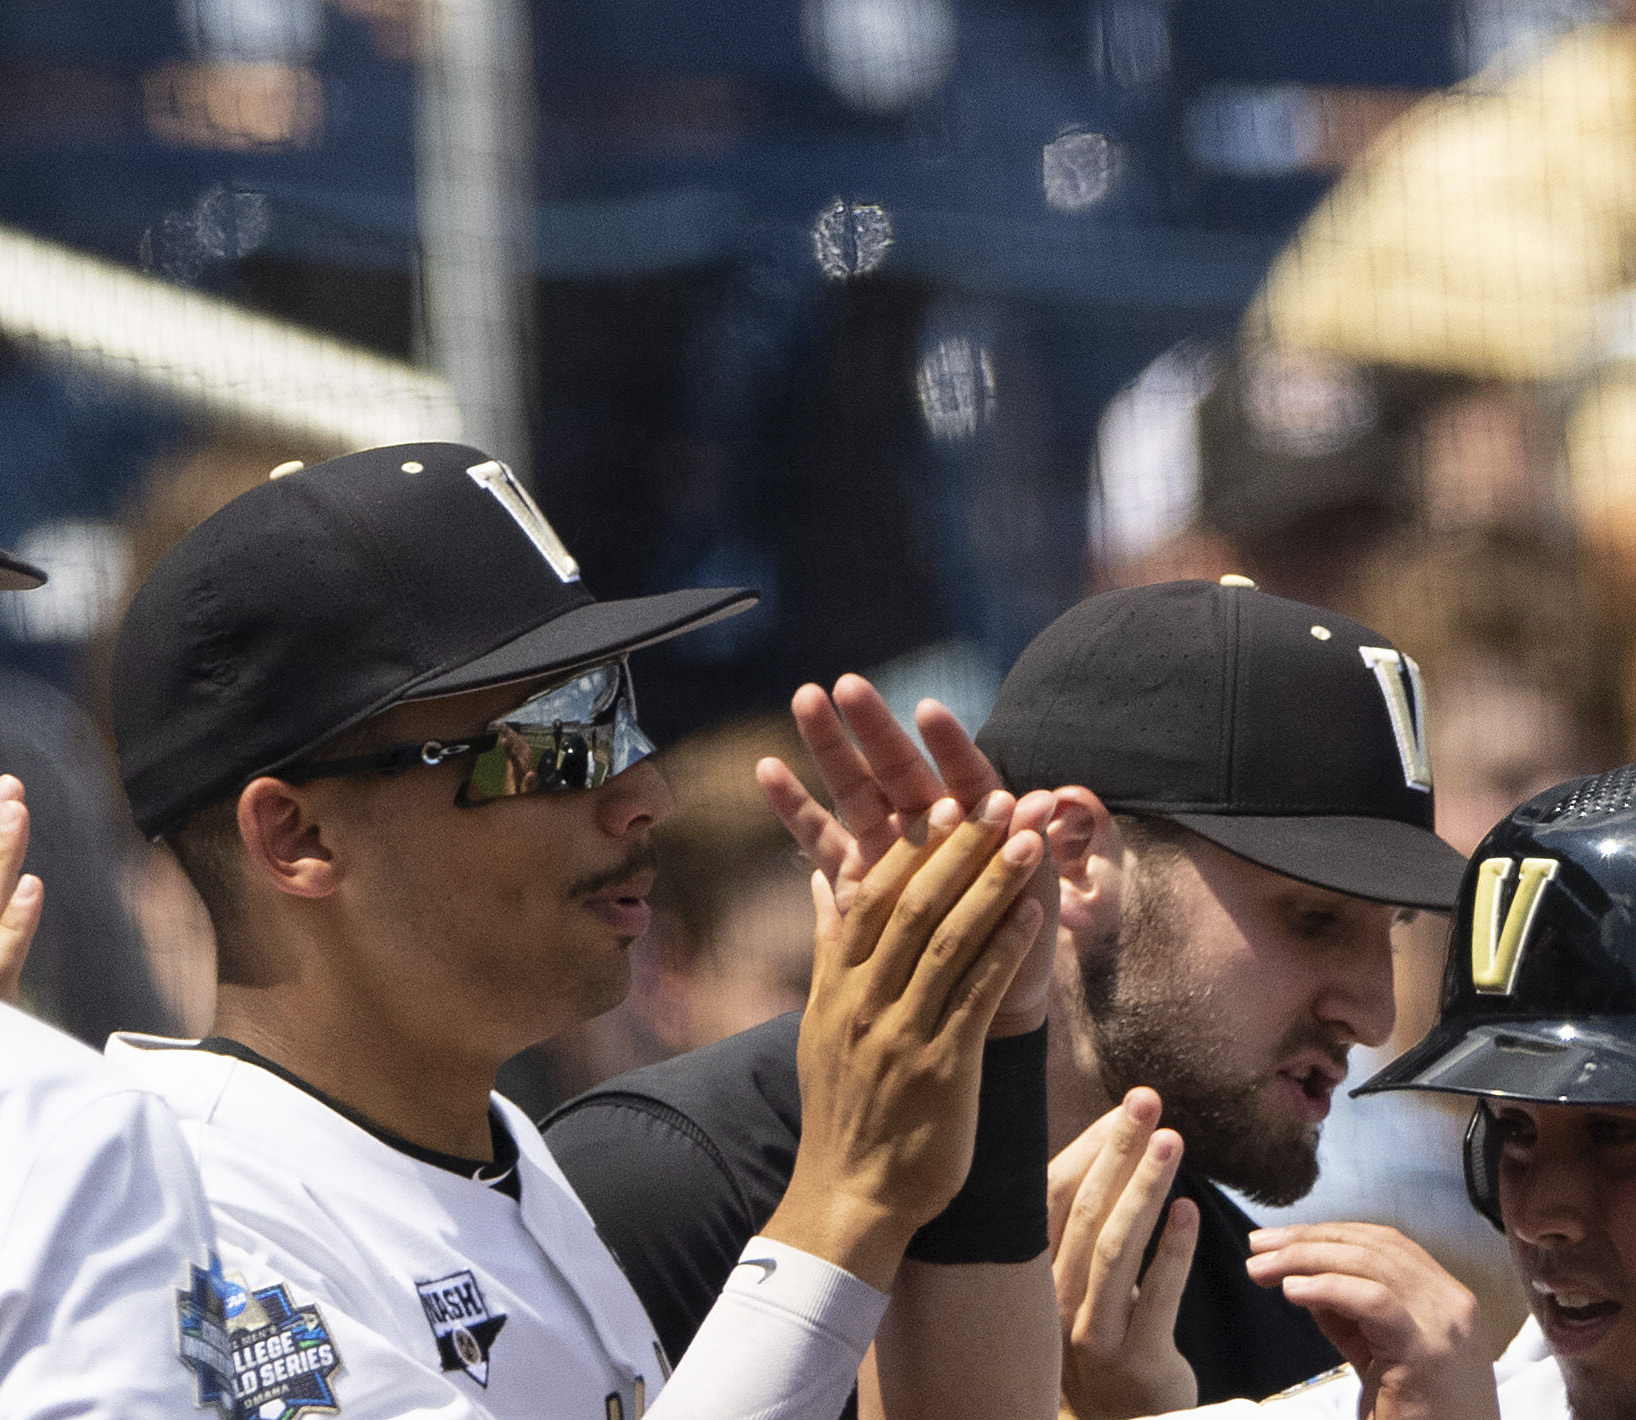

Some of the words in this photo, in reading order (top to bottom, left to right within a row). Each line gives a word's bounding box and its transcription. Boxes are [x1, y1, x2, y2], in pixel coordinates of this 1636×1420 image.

[1360, 646, 1434, 793] V
[1472, 857, 1559, 995] V
[420, 1282, 483, 1323] NASH
[259, 1344, 334, 1387] SERIES
